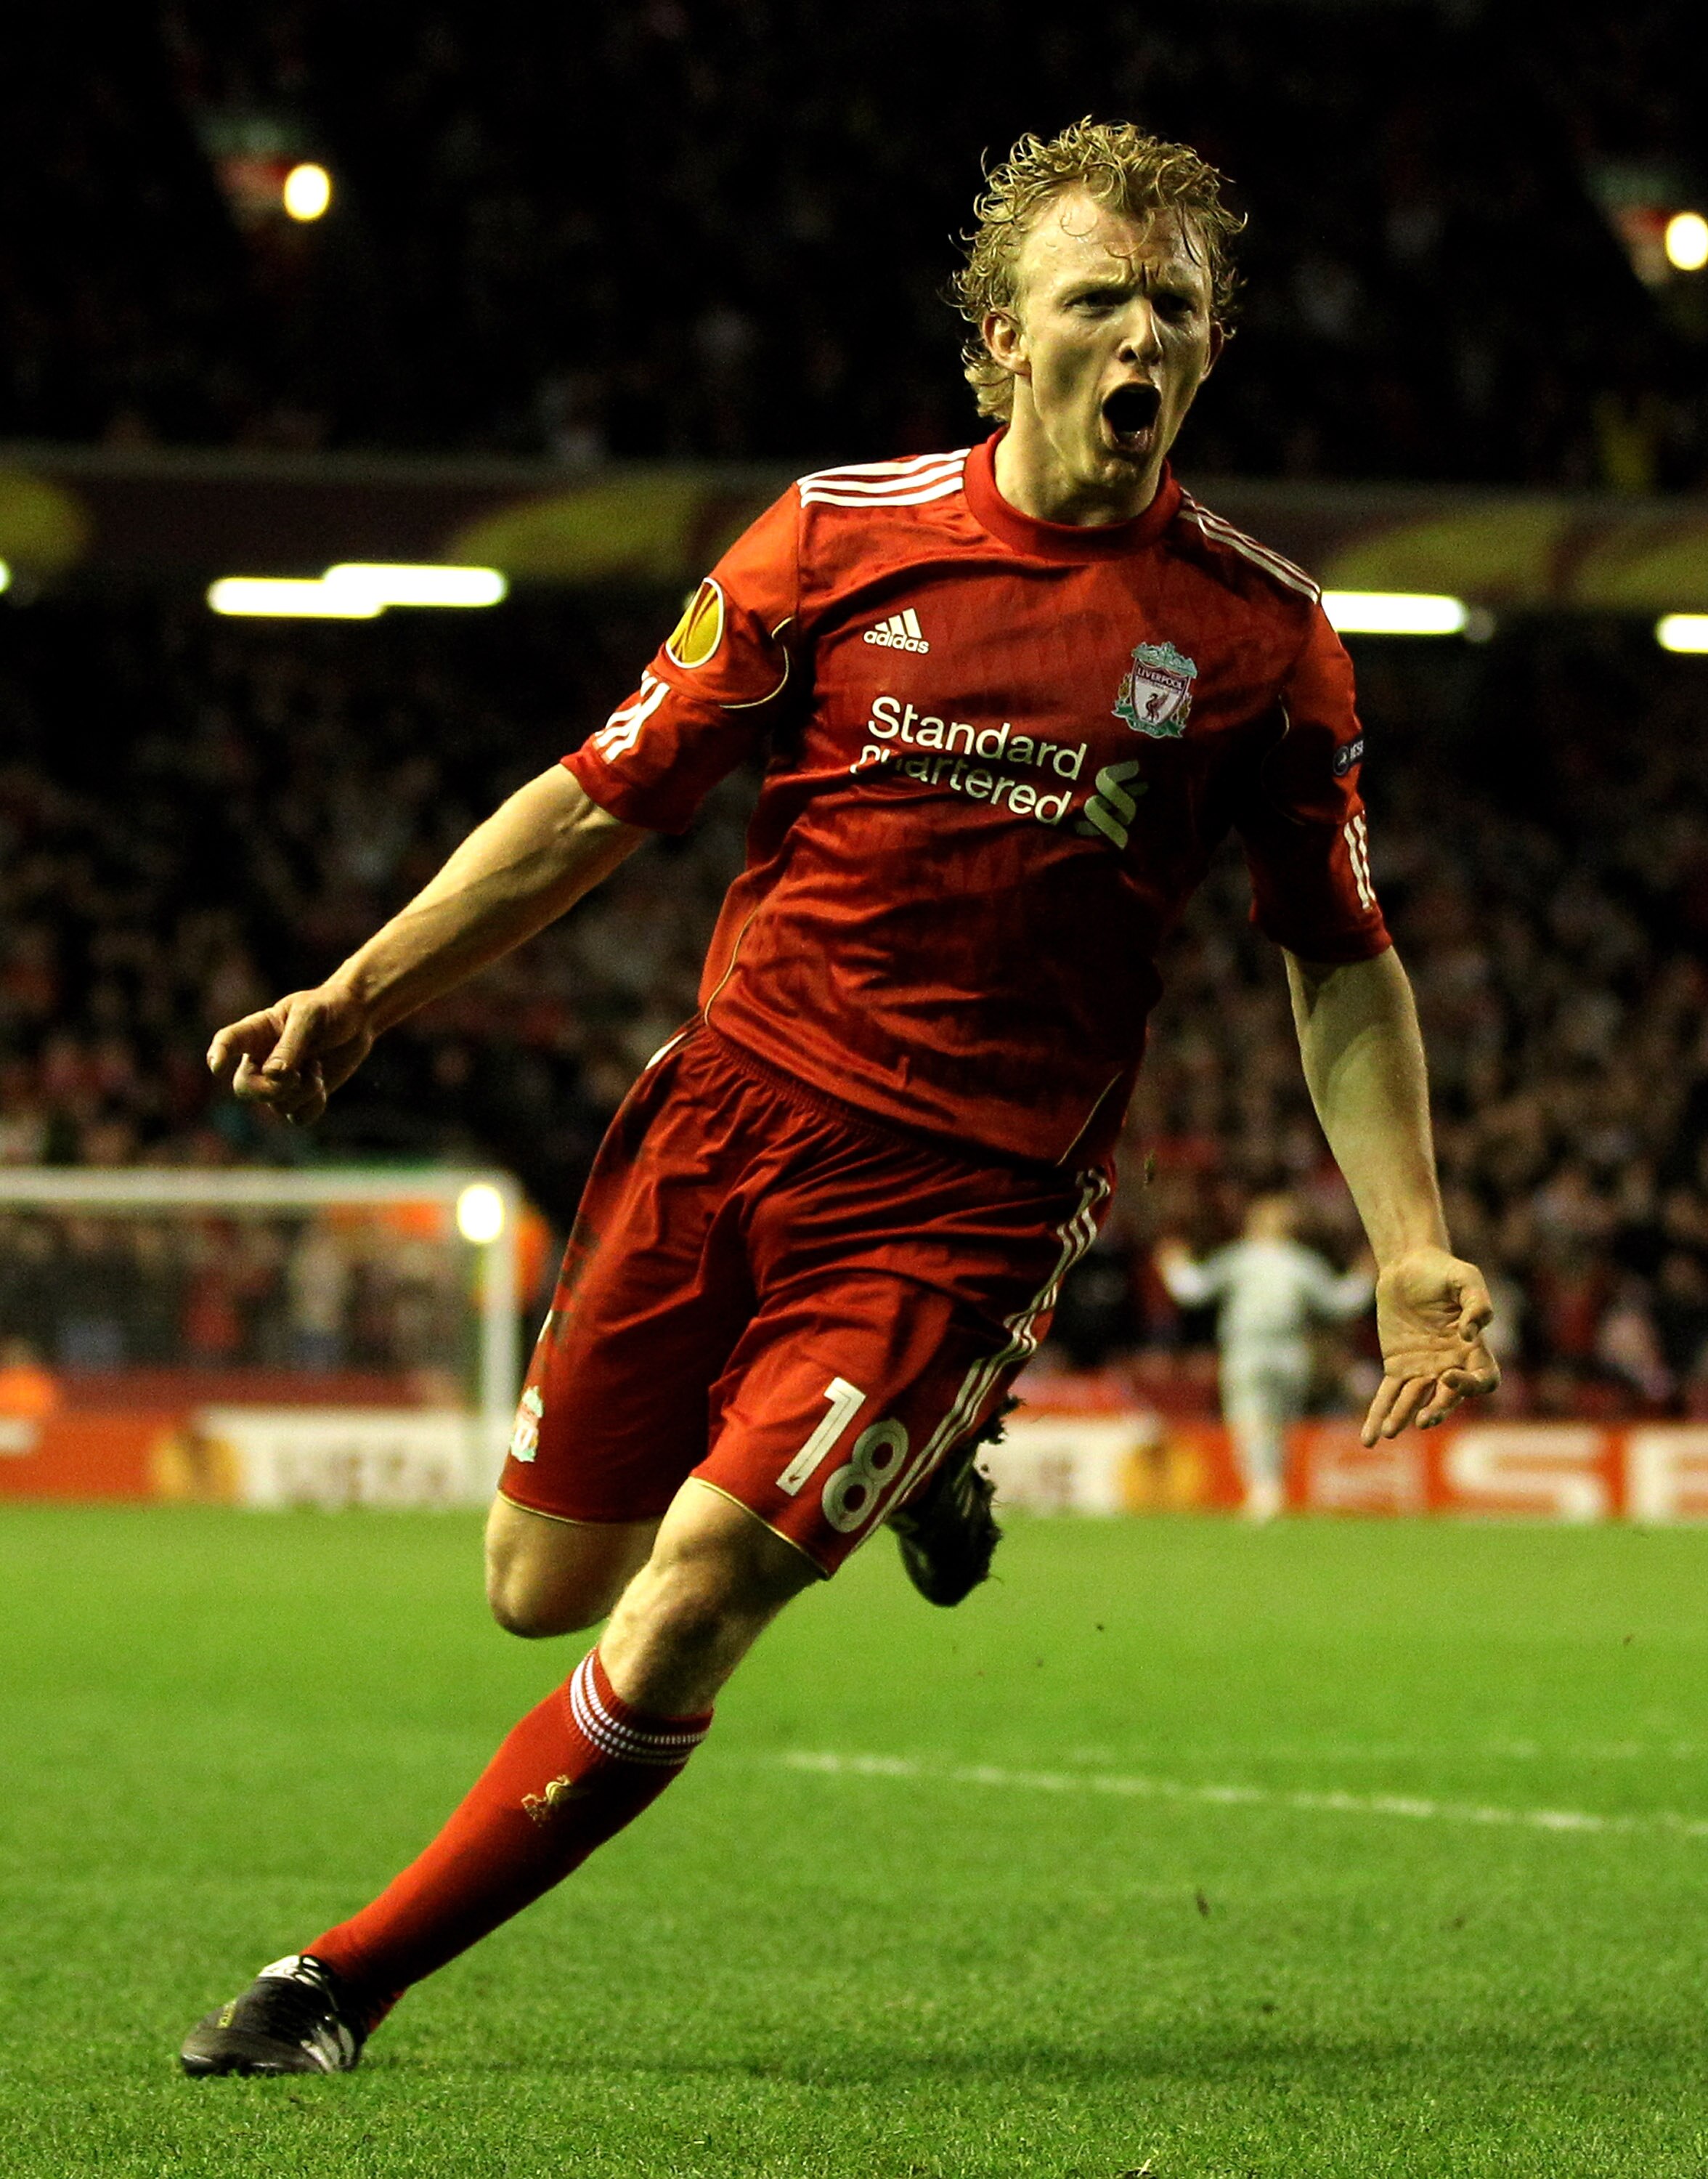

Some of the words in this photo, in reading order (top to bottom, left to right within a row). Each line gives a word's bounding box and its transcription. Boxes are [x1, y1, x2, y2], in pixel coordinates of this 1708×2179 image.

[863, 630, 930, 654] adidas
[1137, 668, 1182, 689] LIVERPOOL
[868, 697, 1087, 781] Standard
[775, 1376, 910, 1533] 18
